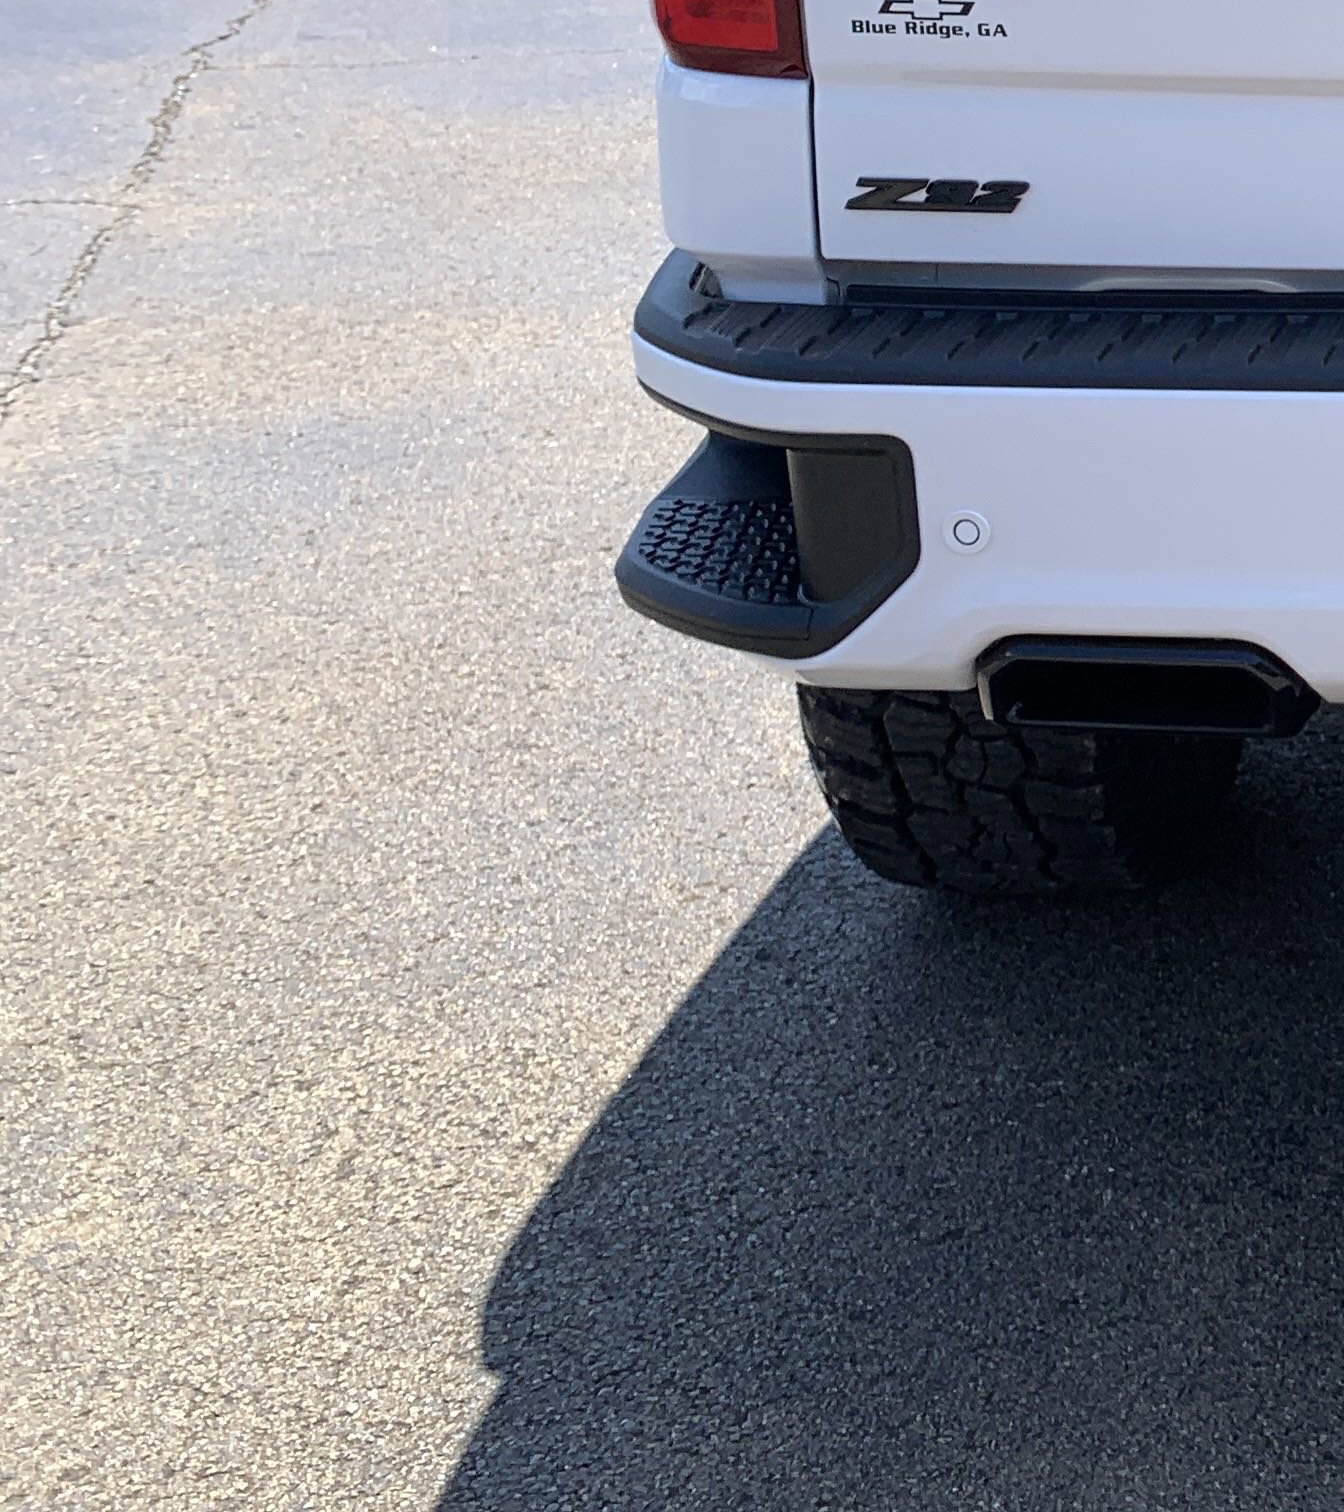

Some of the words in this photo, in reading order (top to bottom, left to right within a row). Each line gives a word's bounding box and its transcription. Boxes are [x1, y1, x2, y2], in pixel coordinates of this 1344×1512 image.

[851, 20, 896, 34] Blue
[905, 21, 970, 38] Ridge,
[977, 23, 1008, 37] GA
